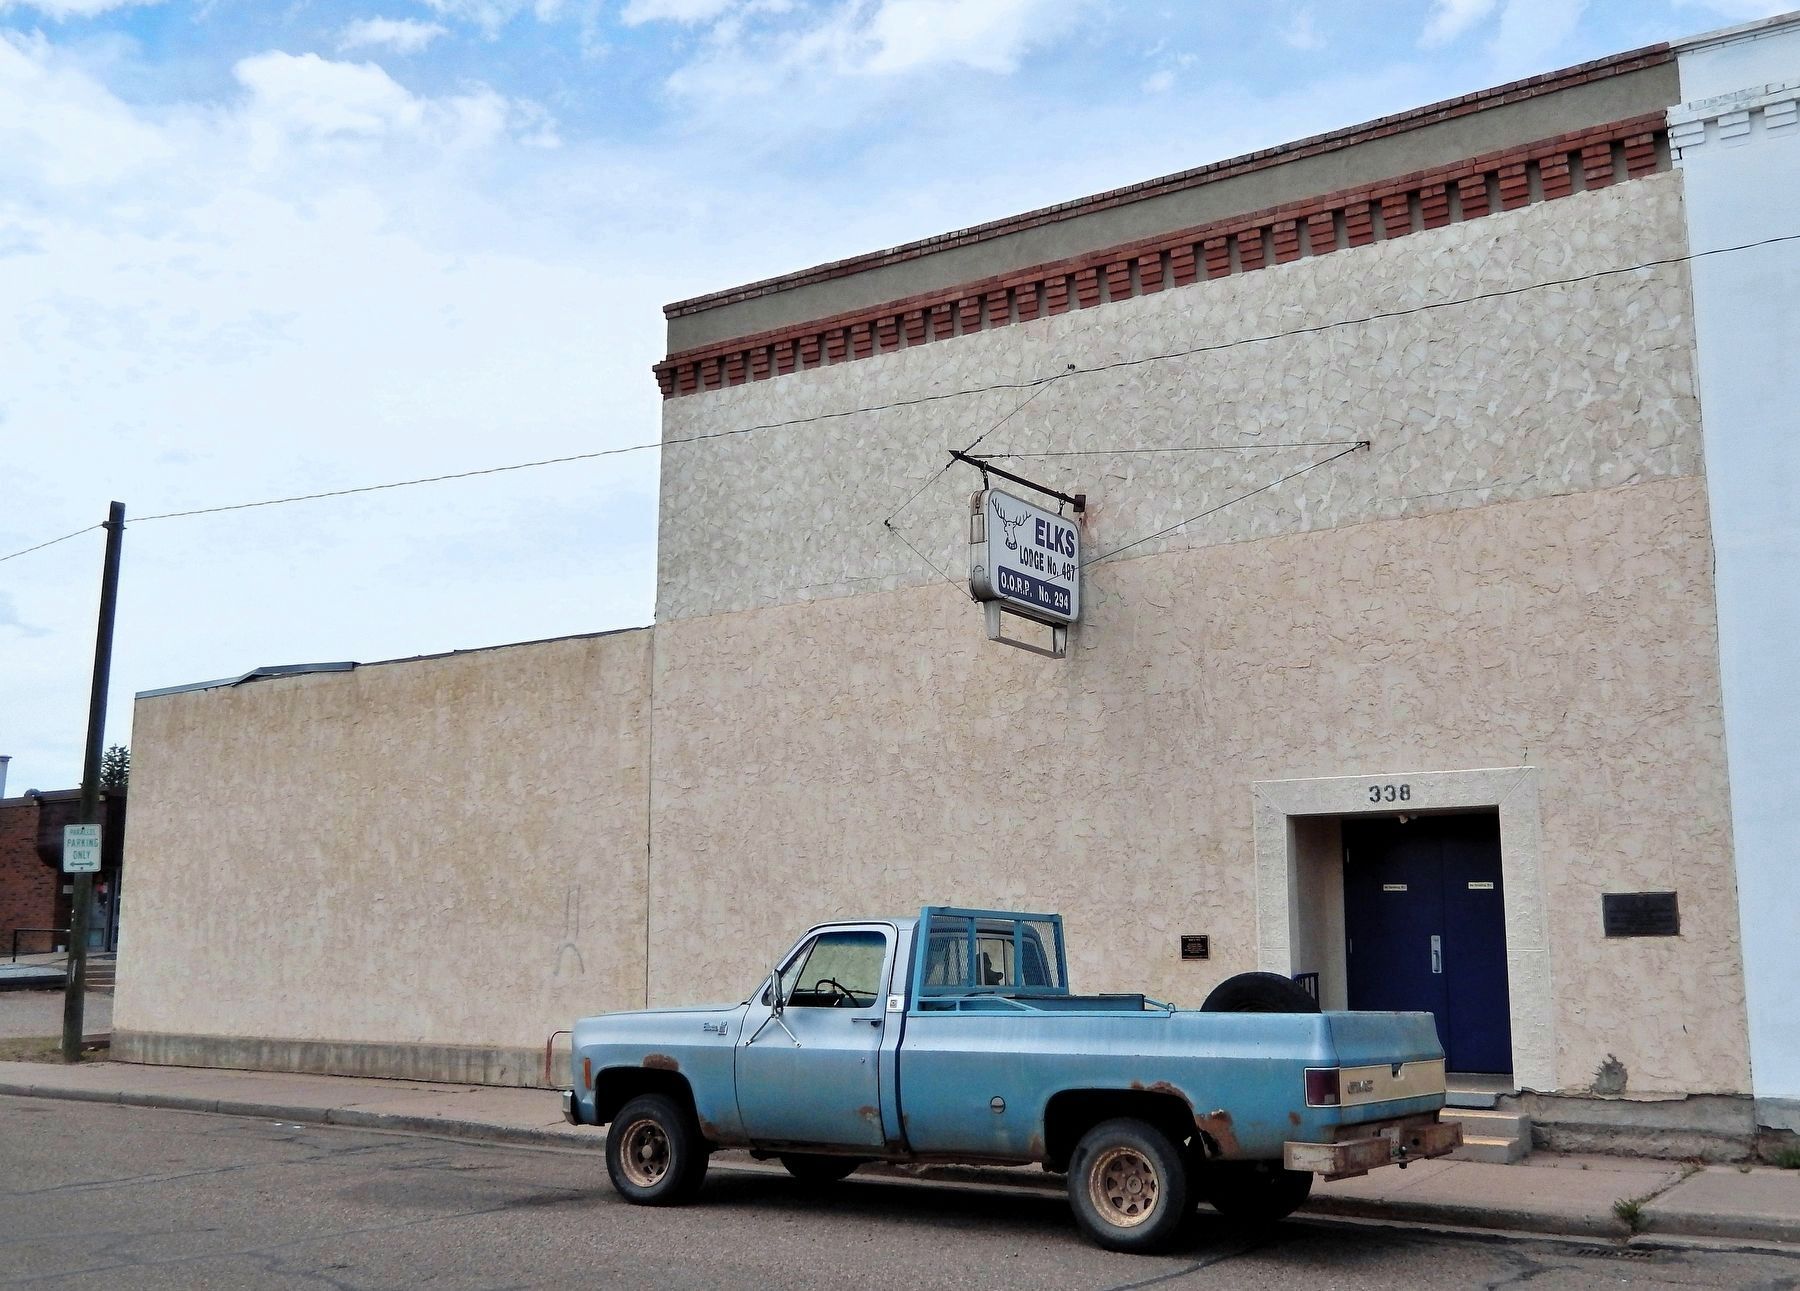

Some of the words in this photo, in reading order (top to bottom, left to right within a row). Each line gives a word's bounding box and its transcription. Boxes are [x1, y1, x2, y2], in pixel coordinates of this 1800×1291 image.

[1035, 517, 1075, 558] ELKS
[1019, 545, 1044, 571] LODGE
[1047, 555, 1060, 576] No.
[1062, 562, 1076, 582] 487
[1038, 585, 1052, 604] No.
[1054, 591, 1069, 609] 294
[1369, 784, 1411, 803] 338
[67, 839, 99, 847] PARKING
[73, 851, 90, 859] ONLY
[1347, 1080, 1374, 1094] GMC
